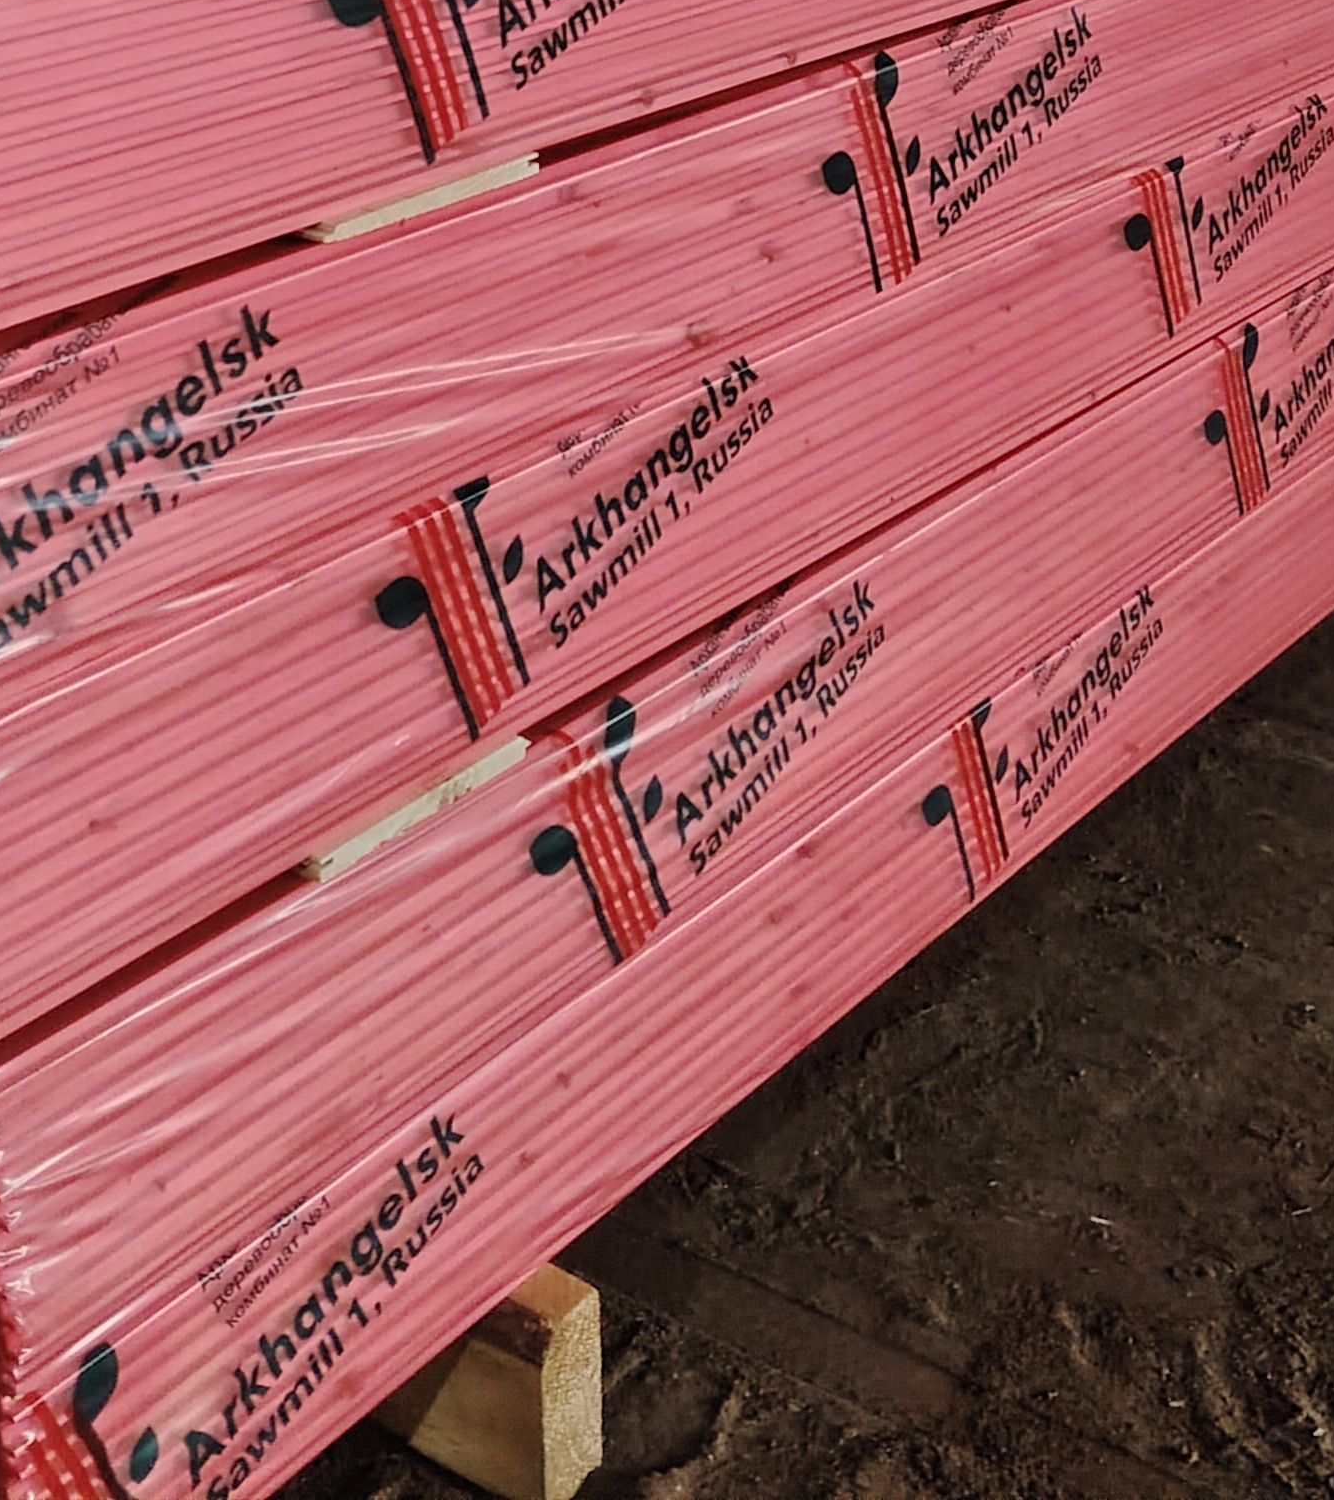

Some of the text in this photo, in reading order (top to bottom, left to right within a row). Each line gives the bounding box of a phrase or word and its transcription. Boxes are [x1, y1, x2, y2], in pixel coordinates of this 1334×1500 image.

[929, 6, 1093, 206] Arkhangelsk
[936, 138, 1018, 238] Sawmill
[1044, 53, 1103, 127] Russia
[1208, 94, 1328, 255] Arkhangelsk
[1213, 192, 1273, 282] Sawmill
[140, 482, 180, 518] 1,
[180, 366, 304, 484] Russia
[535, 355, 759, 614] Arkhangelsk
[550, 515, 663, 649] Sawmill
[692, 397, 774, 495] Russia
[675, 580, 876, 847] Arkhangelsk
[689, 741, 791, 877] Sawmill
[814, 623, 885, 717] Russia
[1016, 584, 1155, 804] Arkhangelsk
[1021, 718, 1089, 829] Sawmill
[1108, 617, 1164, 700] Russia
[185, 1111, 465, 1488] Arkhangelsk
[225, 1232, 301, 1329] комбинат
[301, 1193, 333, 1236] №1
[347, 1299, 384, 1329] 1,
[381, 1152, 485, 1288] Russia
